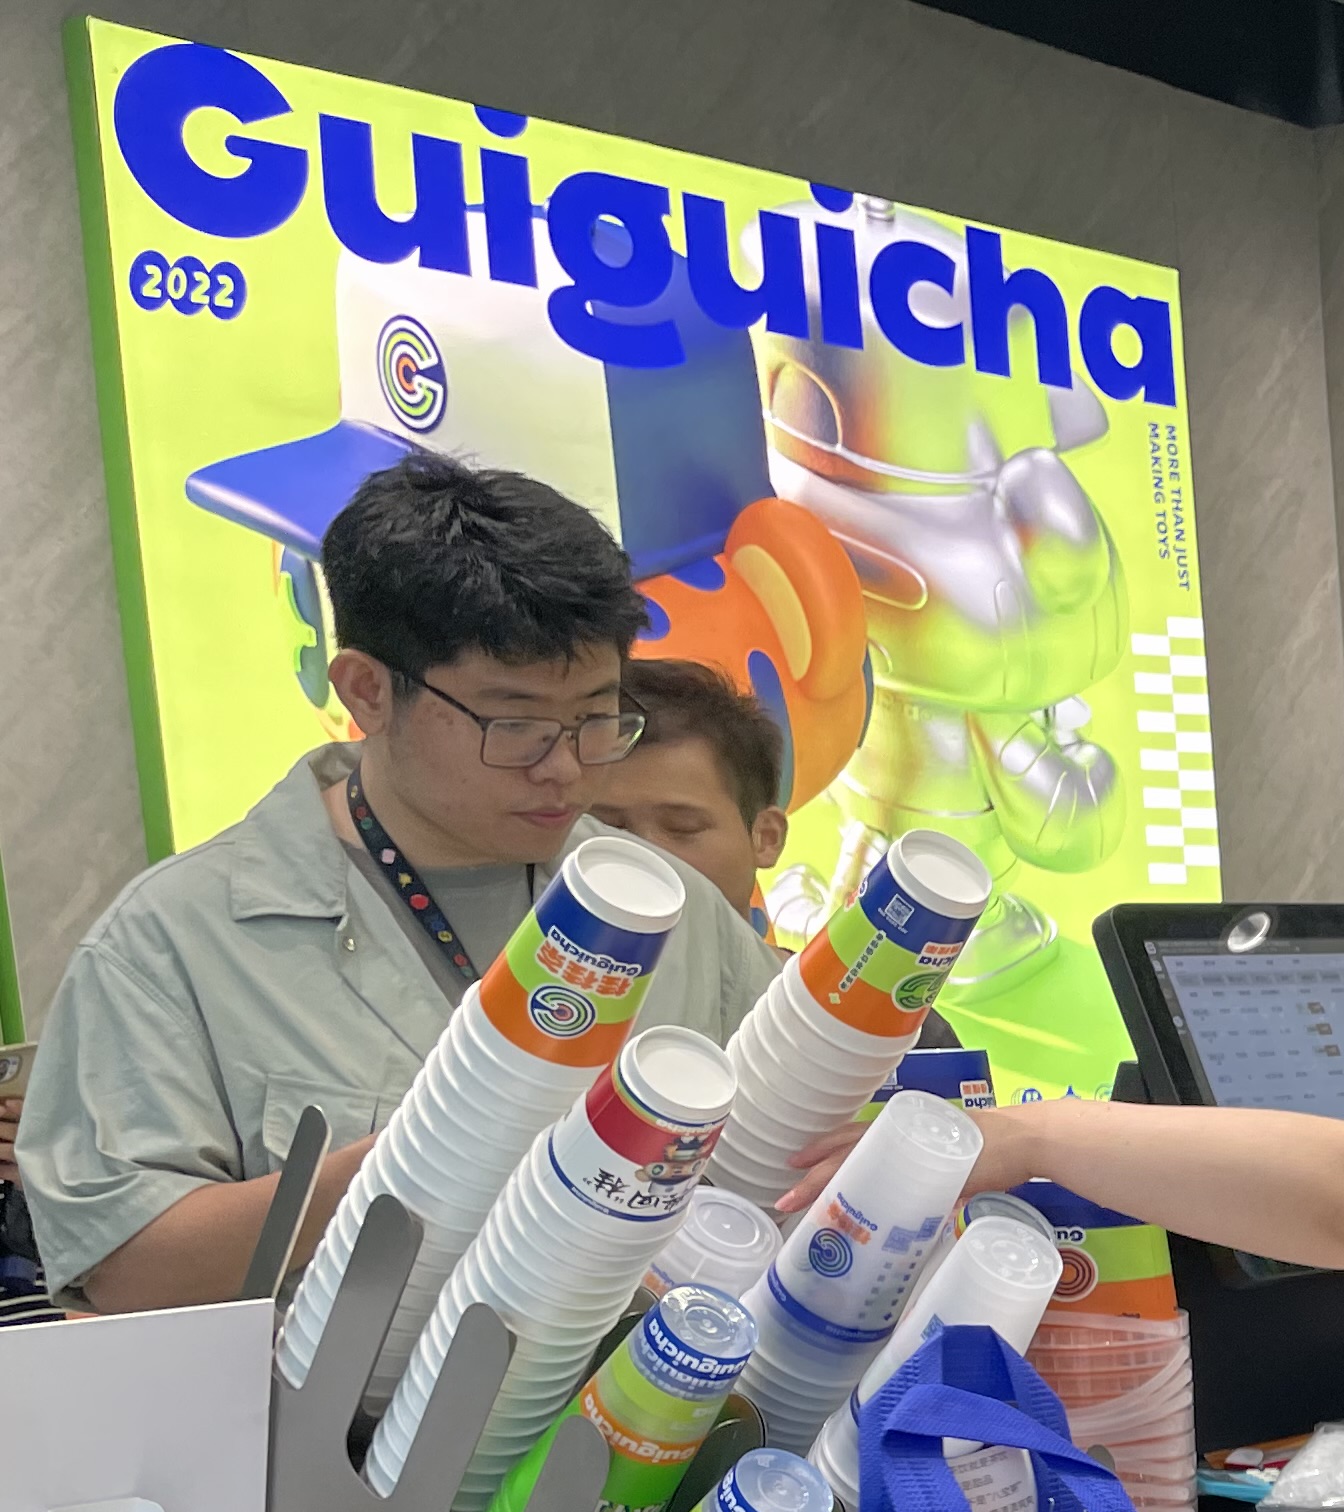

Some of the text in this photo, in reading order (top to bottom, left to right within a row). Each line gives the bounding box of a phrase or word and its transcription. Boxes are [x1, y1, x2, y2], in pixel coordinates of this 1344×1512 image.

[113, 42, 1176, 407] Guiguicha
[142, 263, 235, 308] 2022
[1148, 422, 1170, 561] MAKING TOYS
[1165, 424, 1191, 592] MORE THAN JUST
